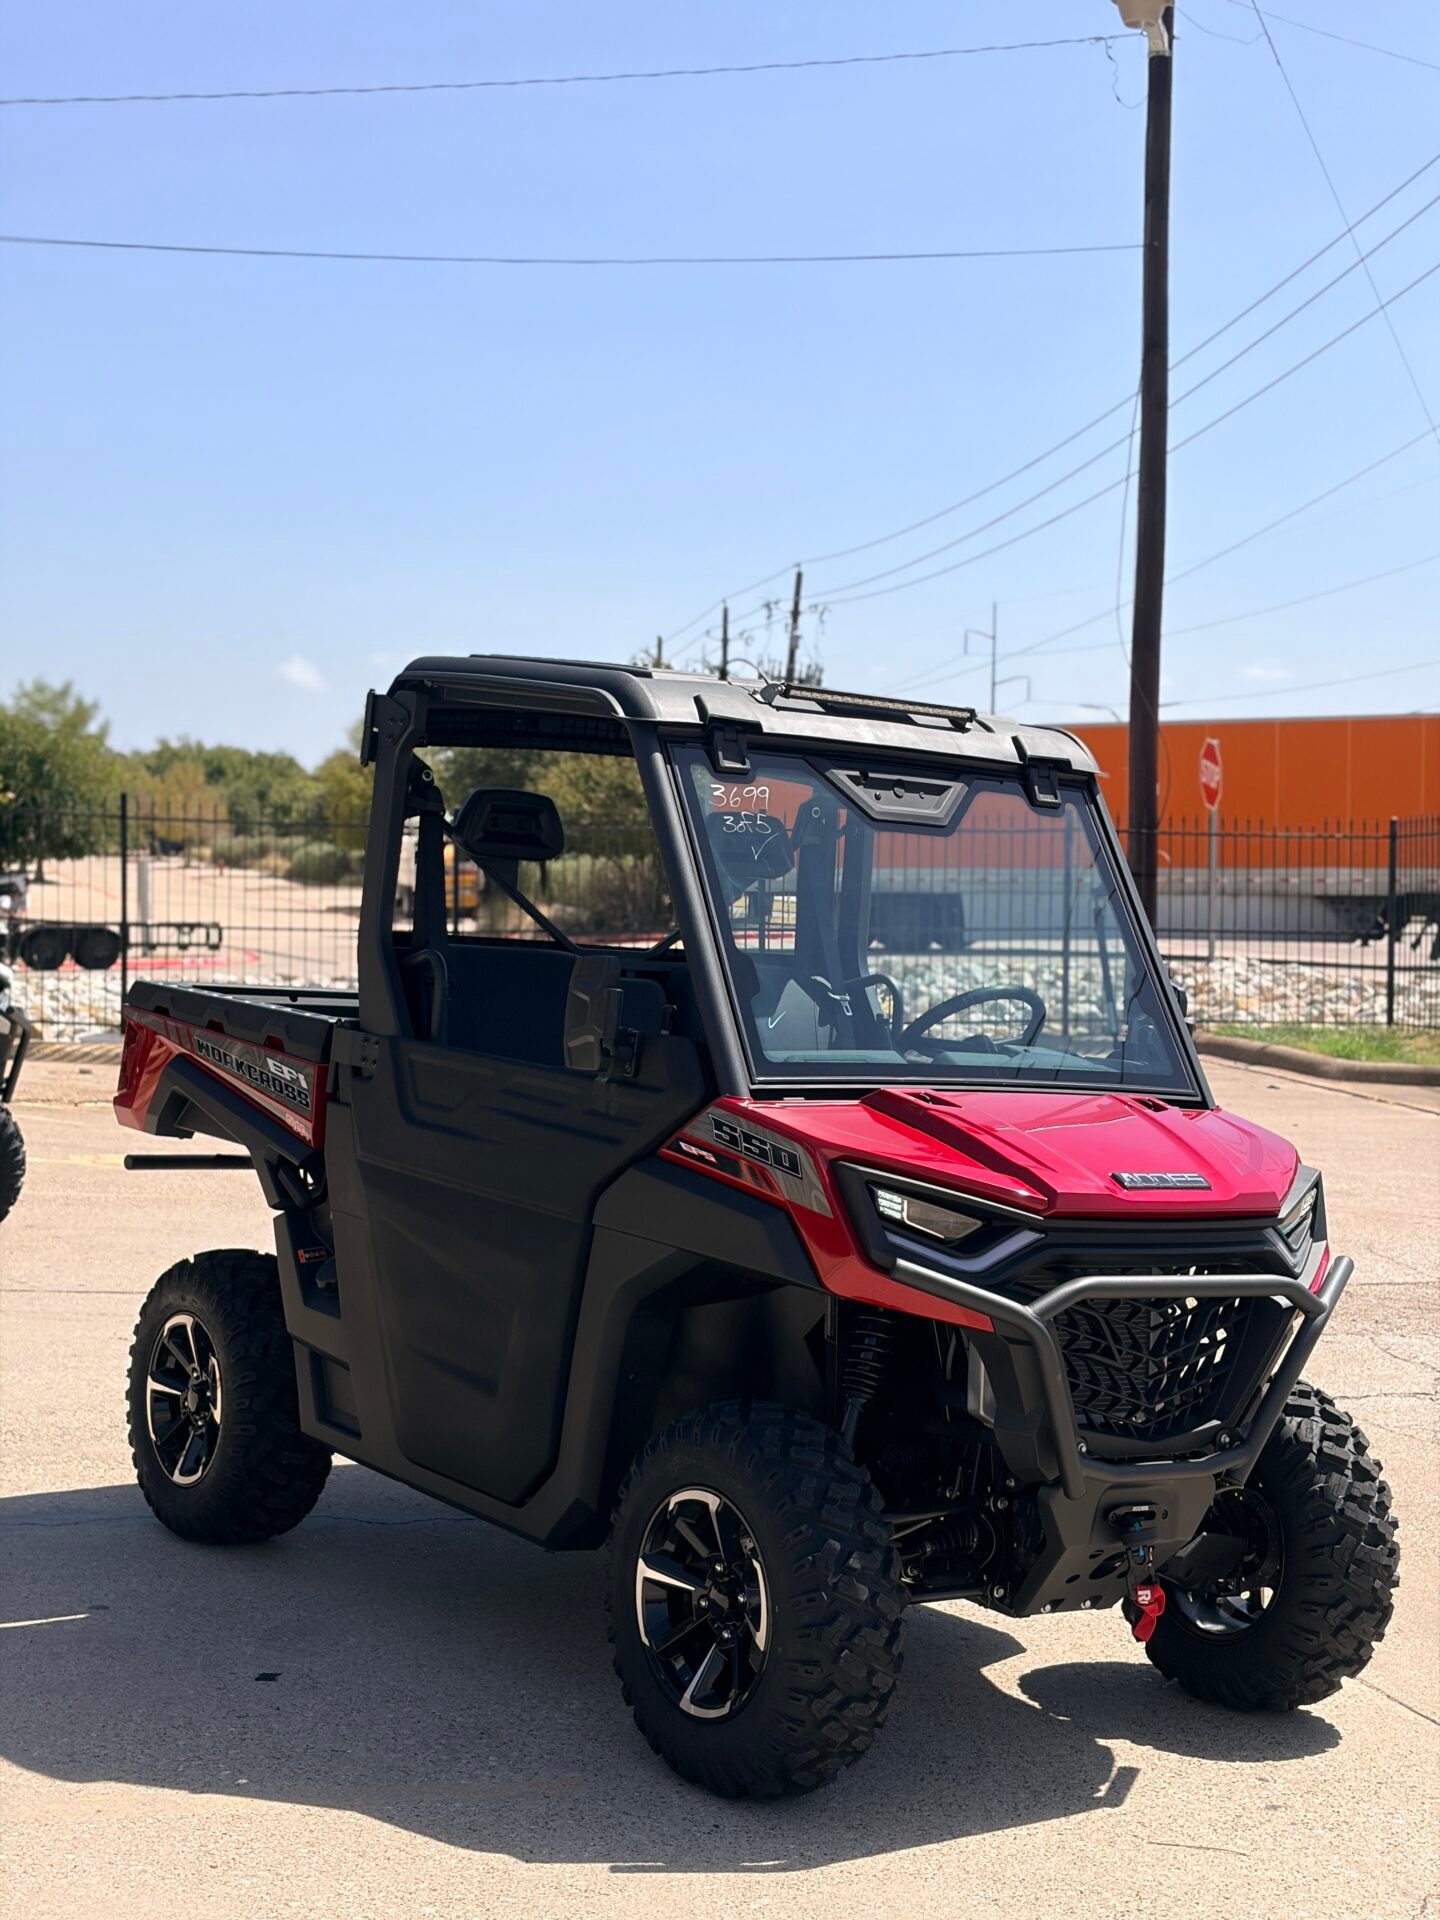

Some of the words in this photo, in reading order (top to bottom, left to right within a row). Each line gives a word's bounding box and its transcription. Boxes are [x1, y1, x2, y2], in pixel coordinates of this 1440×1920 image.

[1201, 759, 1221, 788] STOP
[709, 784, 769, 811] 3699
[194, 1037, 311, 1111] WORKCROSS
